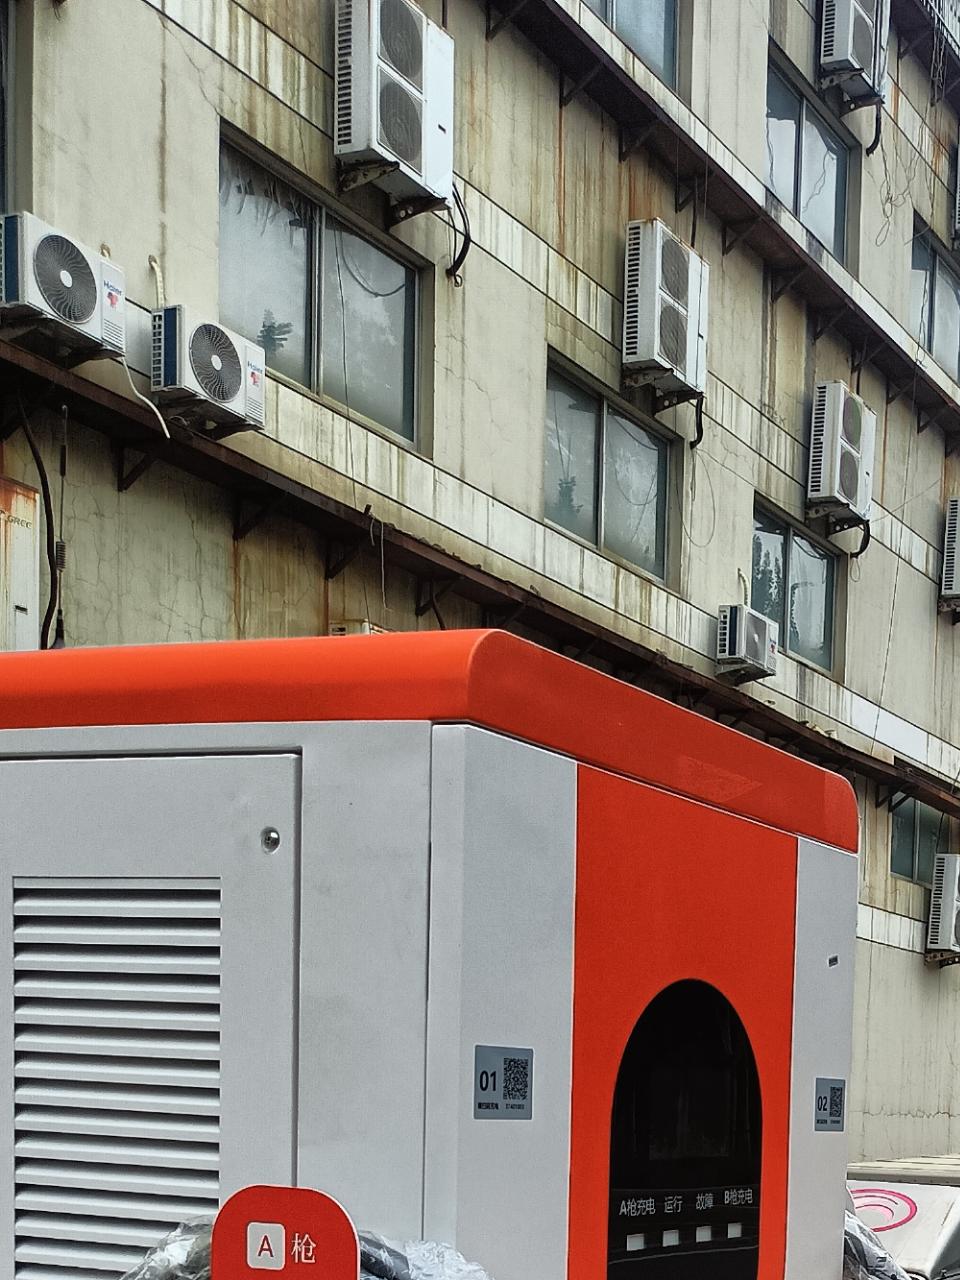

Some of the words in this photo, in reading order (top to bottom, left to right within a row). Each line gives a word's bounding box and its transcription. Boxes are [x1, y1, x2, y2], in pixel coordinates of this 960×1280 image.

[104, 280, 122, 296] Haier
[247, 361, 263, 374] Haier
[7, 514, 32, 529] GREE
[479, 1070, 497, 1092] 01
[817, 1095, 828, 1112] 02
[619, 1197, 656, 1217] A枪充电
[663, 1195, 683, 1213] 运行
[695, 1193, 714, 1210] 故障
[724, 1188, 753, 1205] B枪充电
[257, 1234, 275, 1258] A
[291, 1232, 317, 1263] 枪
